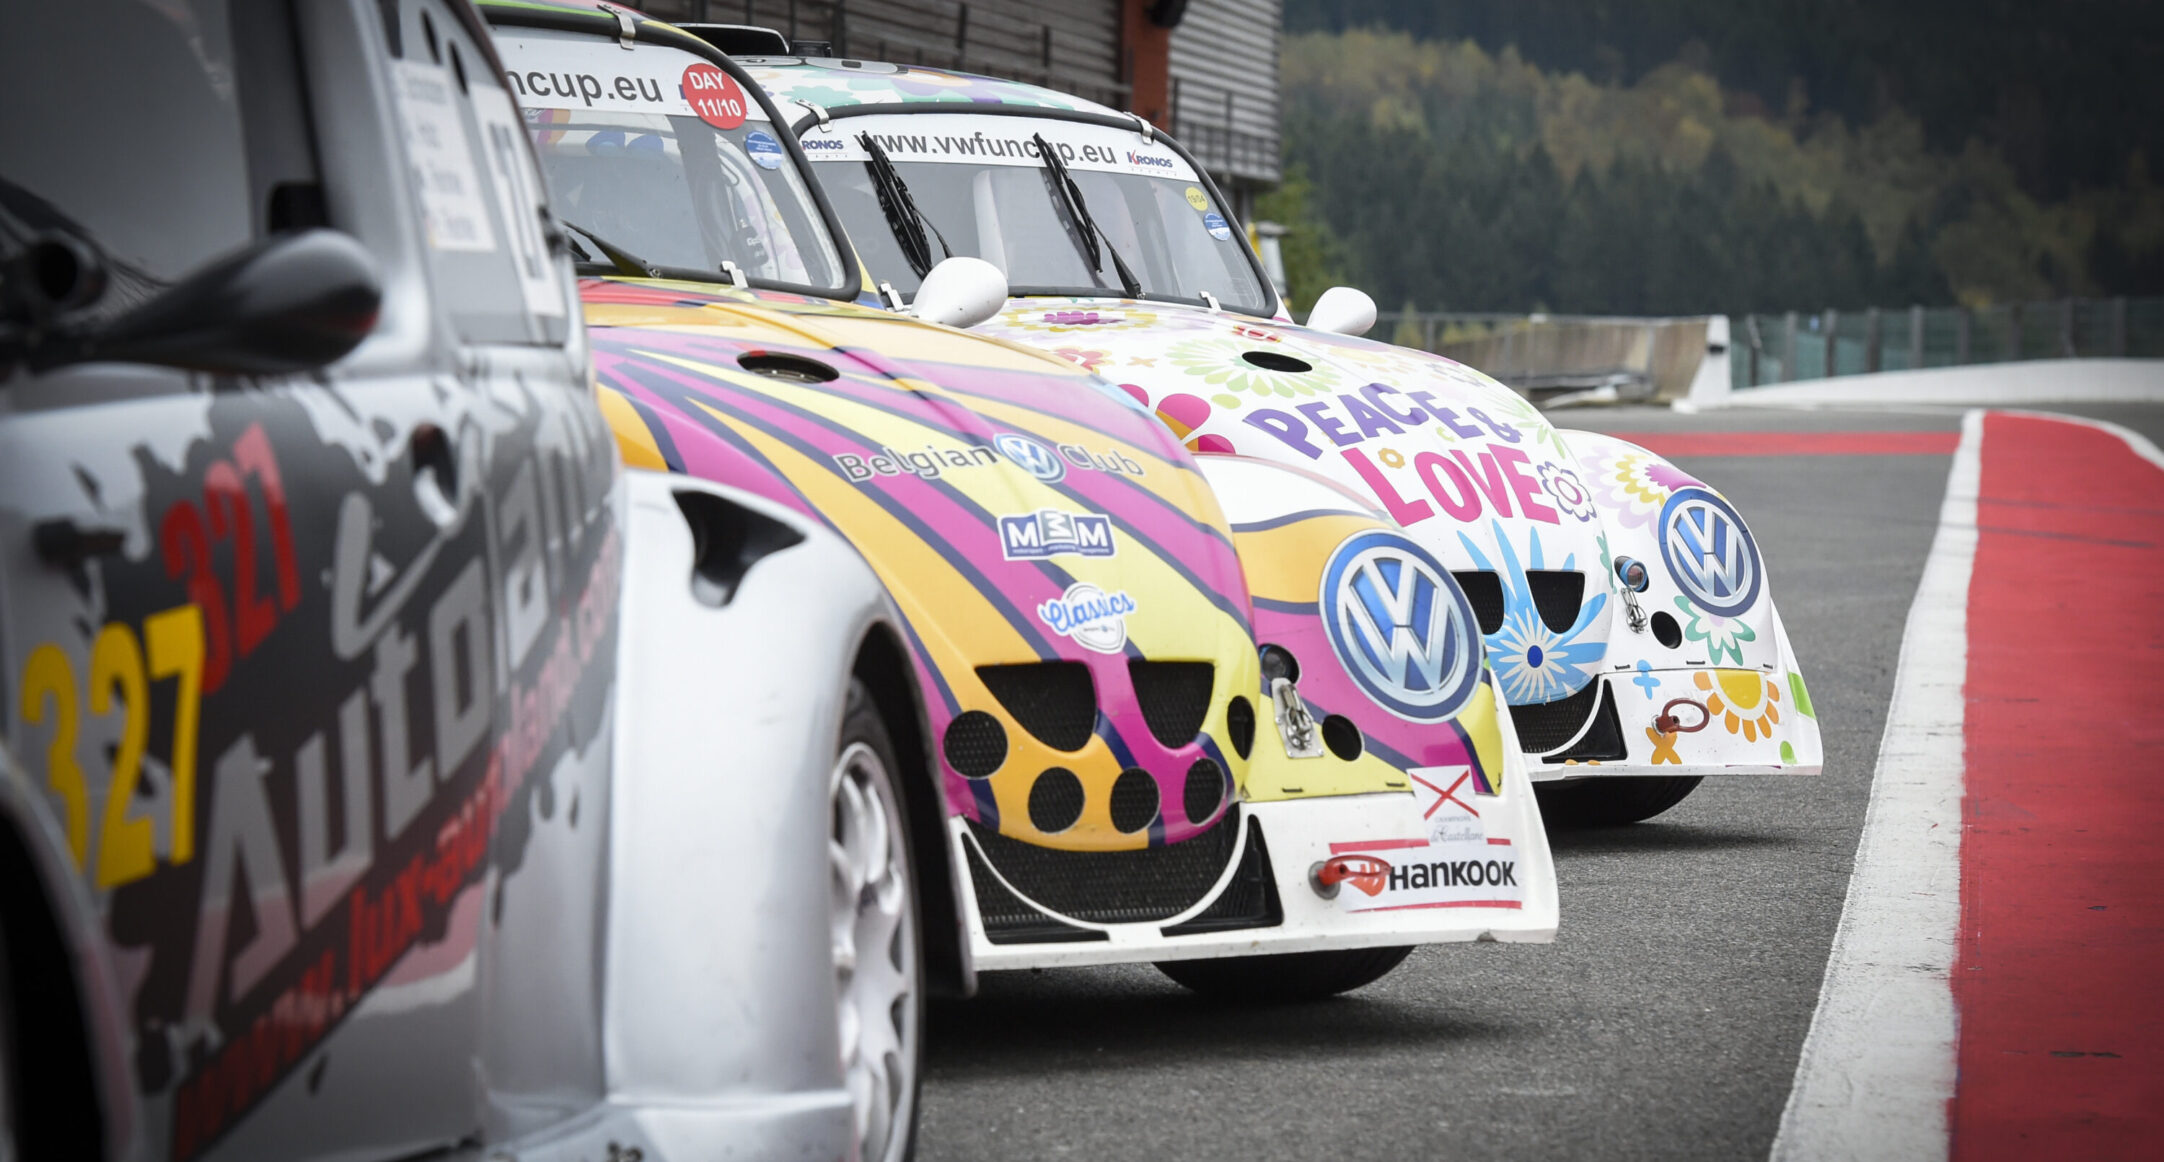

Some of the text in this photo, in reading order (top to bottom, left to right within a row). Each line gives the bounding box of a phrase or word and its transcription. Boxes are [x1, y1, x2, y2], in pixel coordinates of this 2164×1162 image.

[688, 71, 725, 90] DAY
[698, 98, 742, 118] 11/10
[801, 139, 844, 151] RONOS
[1126, 150, 1173, 168] KRONOS
[1242, 382, 1524, 460] PEACE &
[836, 445, 998, 481] Belgian
[1059, 445, 1145, 476] Club
[1340, 443, 1561, 528] LOVE
[160, 421, 302, 696] 327
[1667, 498, 1753, 608] VW
[1041, 593, 1135, 632] Classics
[1336, 545, 1470, 707] VW
[20, 603, 207, 890] 327
